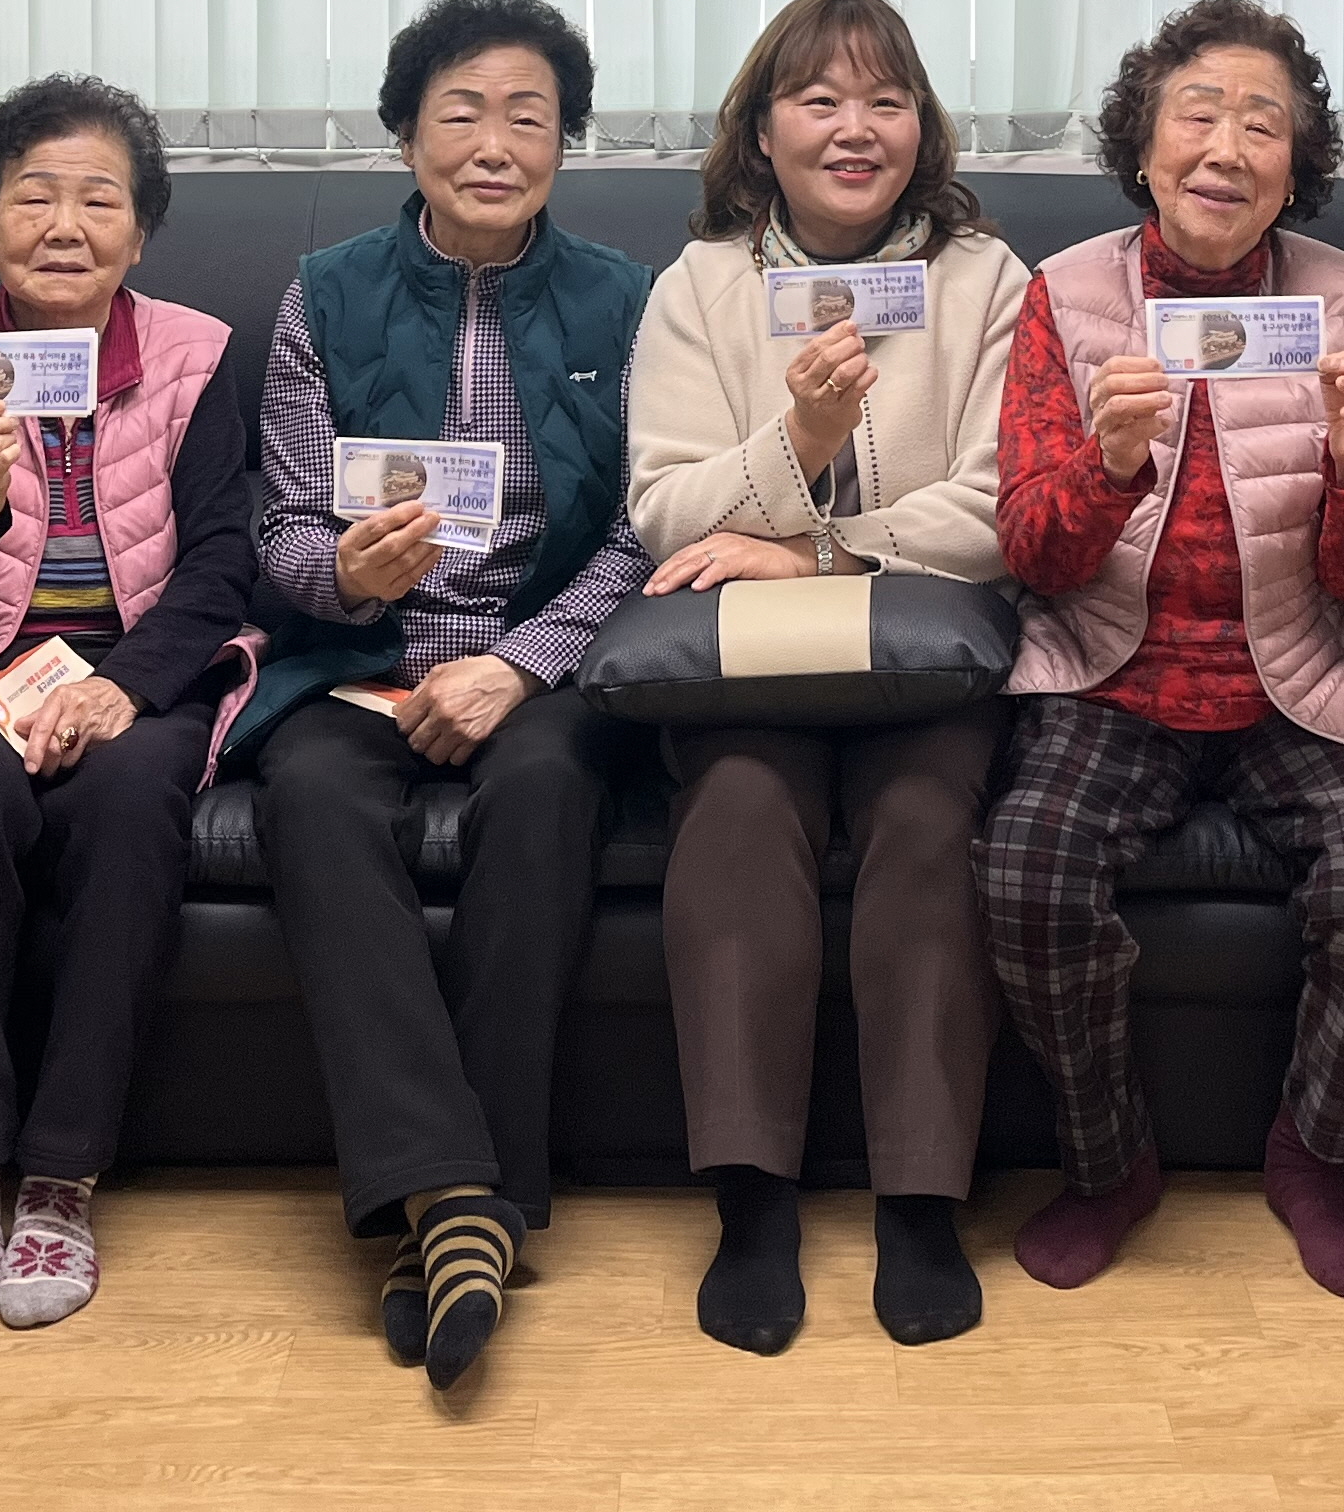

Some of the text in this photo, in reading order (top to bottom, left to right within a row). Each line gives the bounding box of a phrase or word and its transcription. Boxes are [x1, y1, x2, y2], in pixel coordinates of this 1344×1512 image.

[876, 311, 918, 326] 10,000
[1268, 351, 1312, 366] 10,000
[35, 390, 81, 404] 10,000
[446, 493, 488, 511] 10,000
[437, 523, 481, 539] 10,000
